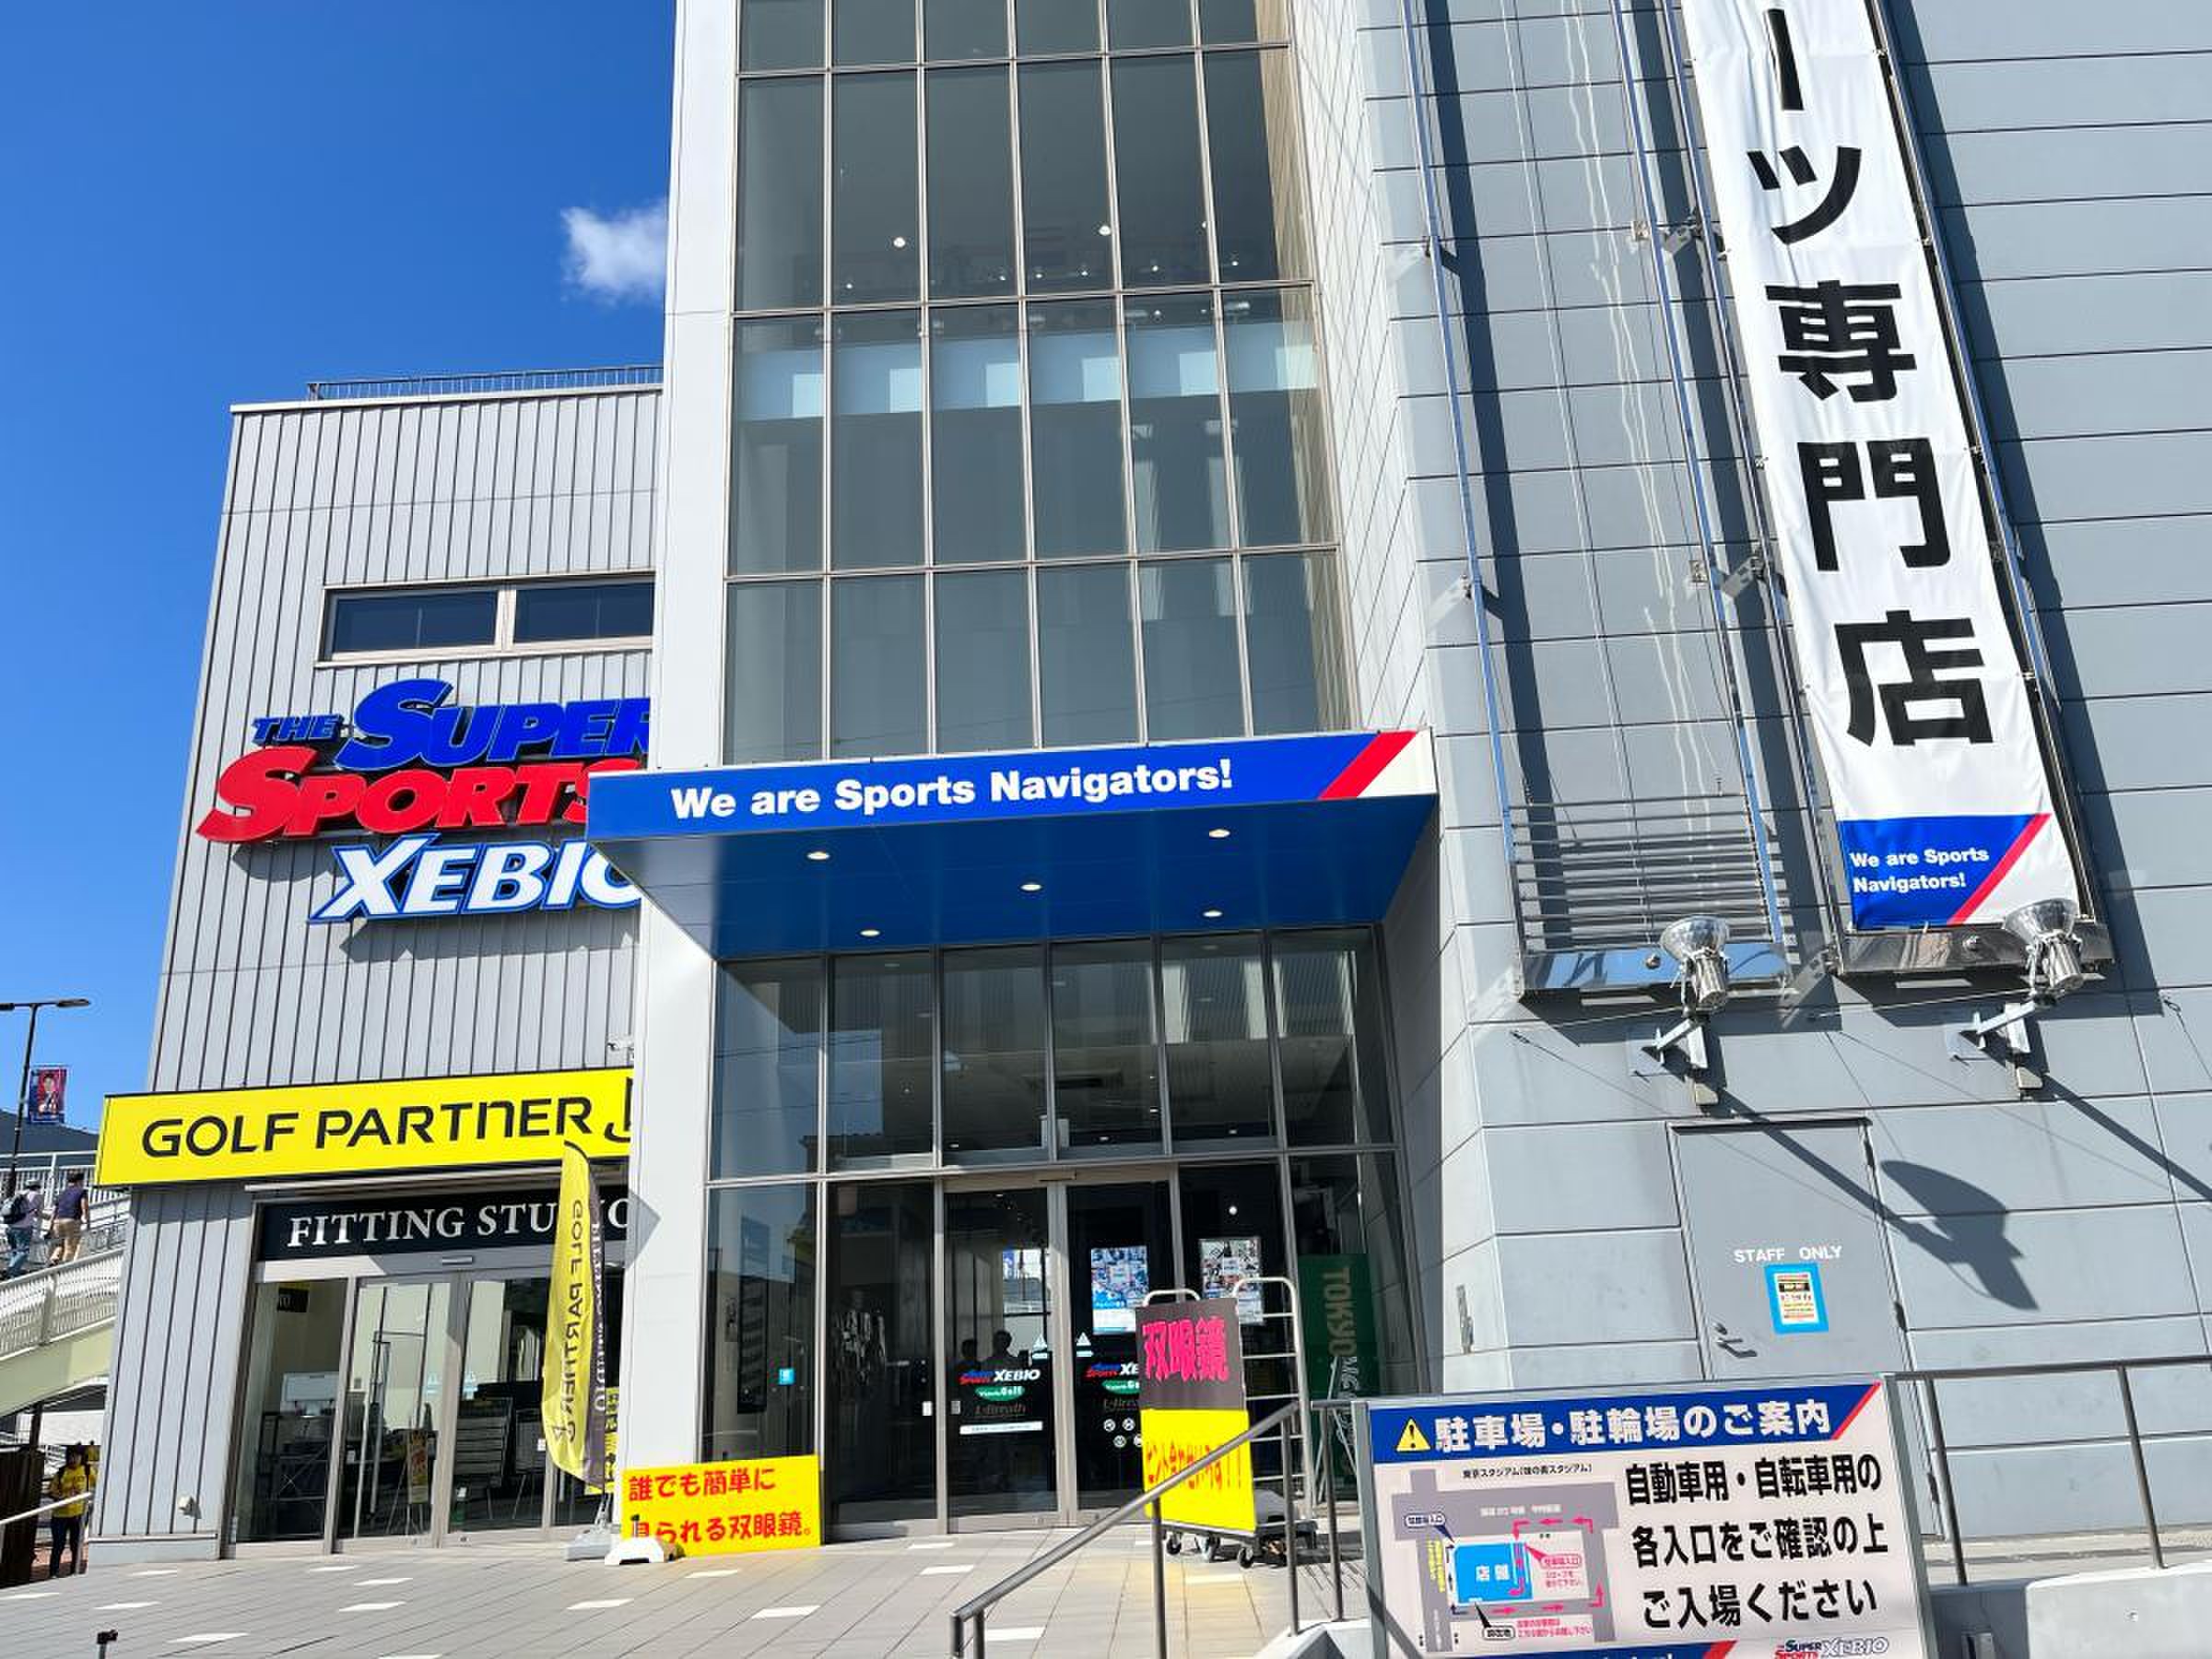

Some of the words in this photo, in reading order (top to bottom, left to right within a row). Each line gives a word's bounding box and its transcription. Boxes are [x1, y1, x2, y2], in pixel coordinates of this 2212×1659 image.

[253, 714, 345, 745] THE
[671, 786, 736, 820] We
[749, 787, 821, 816] are
[834, 776, 976, 814] Sports
[990, 759, 1234, 803] Navigators!
[1850, 852, 1880, 868] We
[1887, 852, 1919, 866] are
[1924, 846, 1989, 865] Sports
[1853, 872, 1966, 894] Navigators!
[142, 1112, 300, 1158] GOLF
[315, 1096, 592, 1149] PARTNER
[287, 1206, 465, 1248] FITTING
[477, 1198, 629, 1237] STUO
[1734, 1248, 1785, 1264] STAFF
[1798, 1246, 1842, 1260] ONLY
[1322, 1267, 1358, 1357] TOKYO
[1143, 1317, 1230, 1382] 双眼鏡
[1434, 1399, 1831, 1453] 駐車場・駐輪場のご案内
[629, 1467, 776, 1502] 誰でも簡単に
[1625, 1453, 1881, 1506] 自動車用・自転車用の
[1631, 1516, 1888, 1569] 各入口をご確認の上
[1642, 1578, 1877, 1630] ご入場ください
